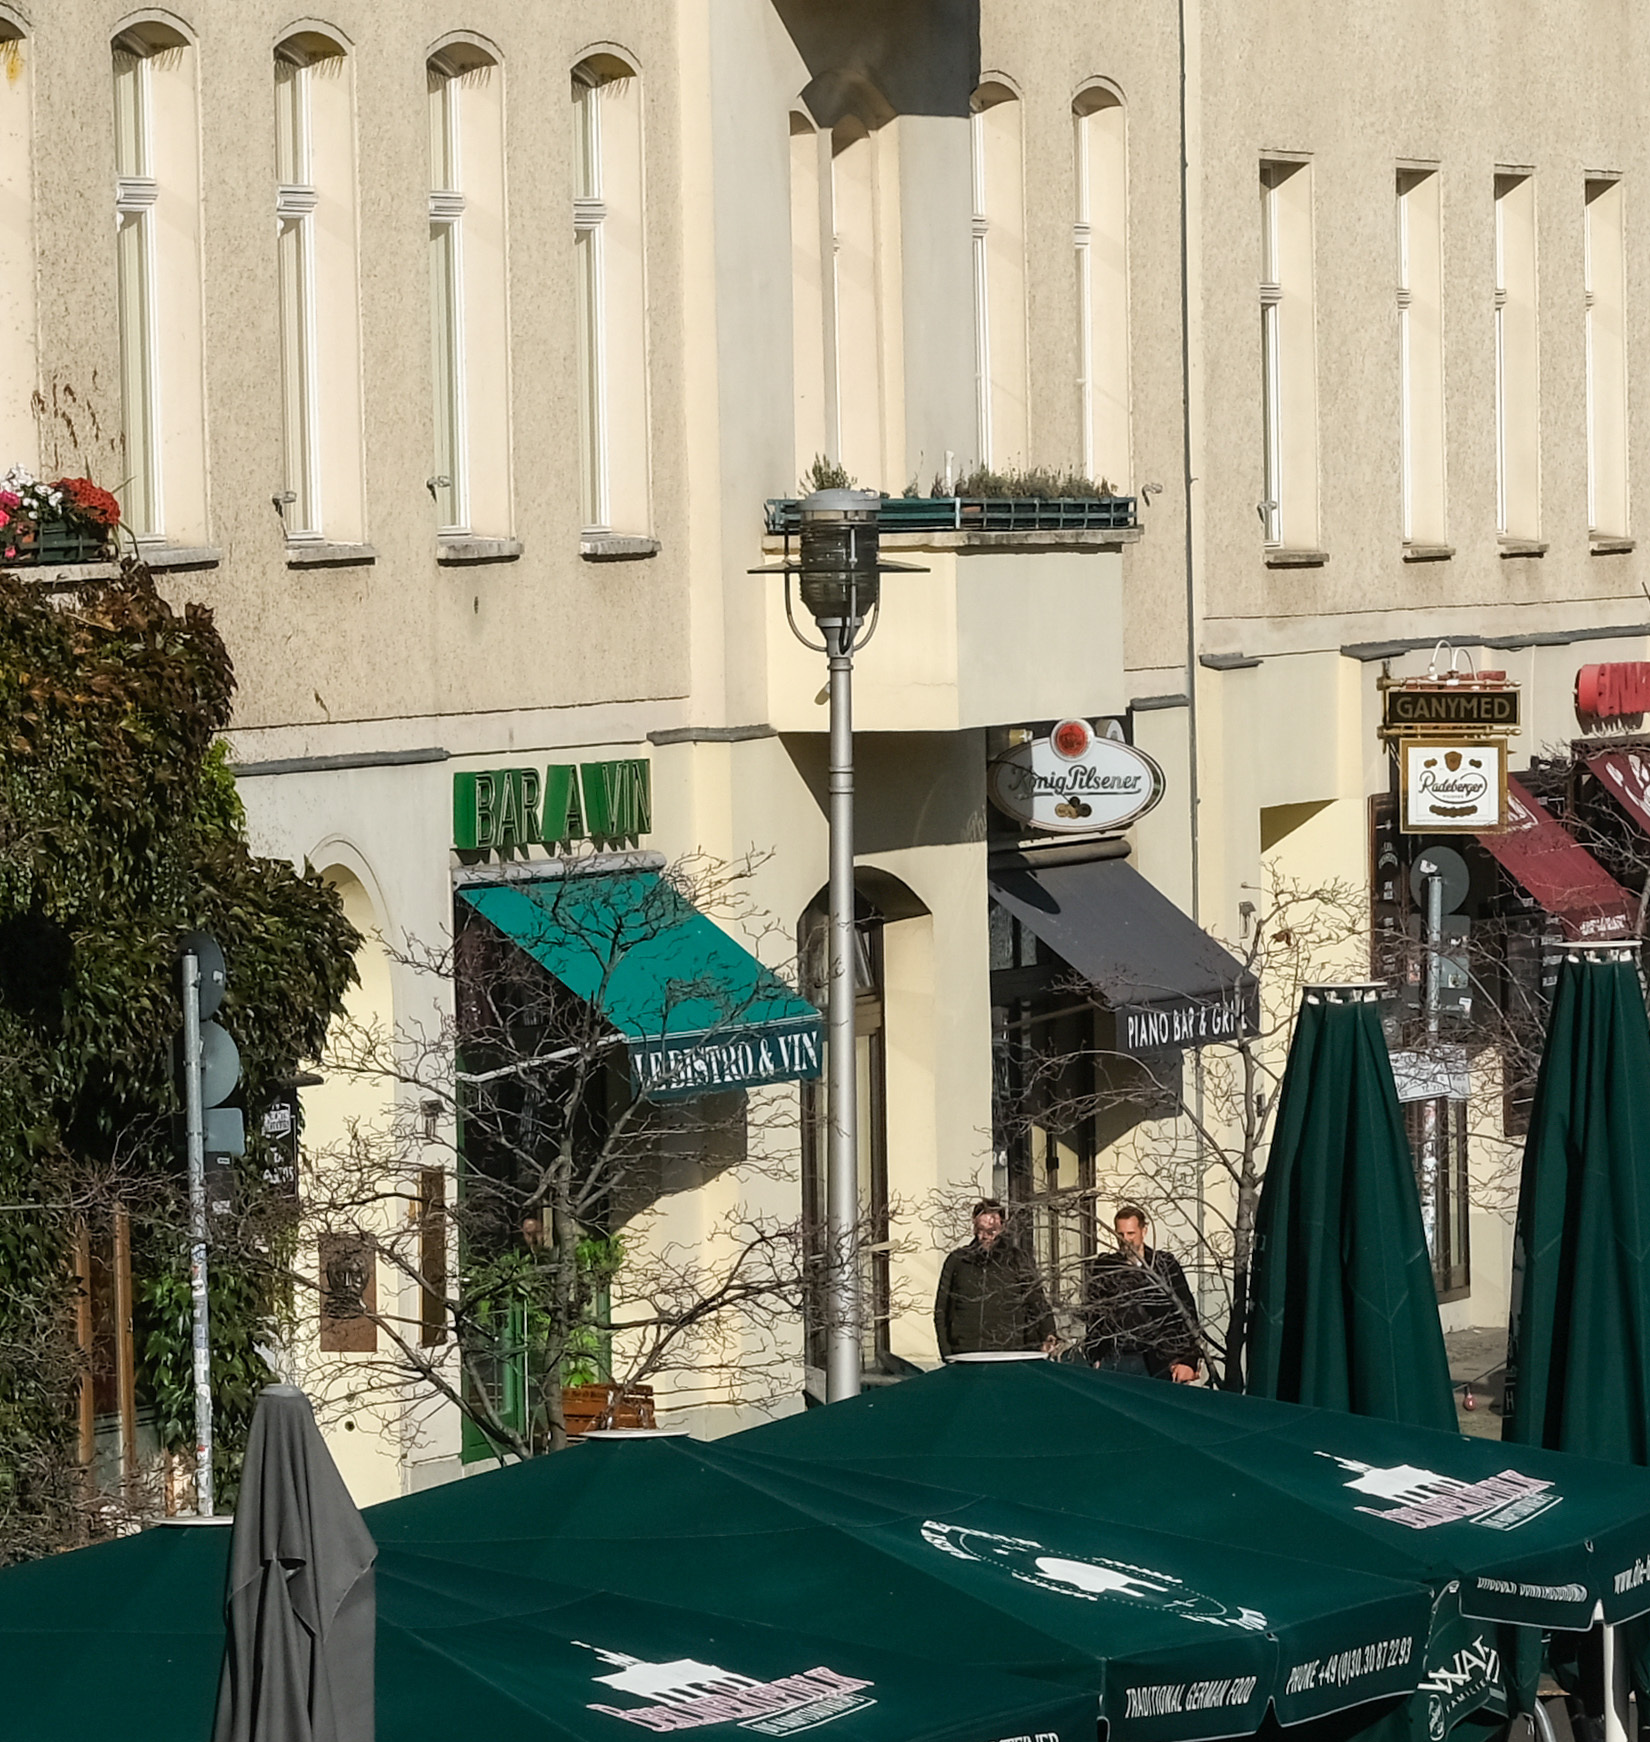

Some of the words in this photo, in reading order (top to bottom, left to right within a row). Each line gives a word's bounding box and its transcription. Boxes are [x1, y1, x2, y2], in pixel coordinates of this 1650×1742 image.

[1396, 696, 1511, 719] GANYMED
[1066, 764, 1143, 791] Pilsener
[472, 768, 544, 849] BAR
[597, 759, 651, 837] VIN
[1127, 1012, 1169, 1050] PIANO
[1173, 1006, 1195, 1042] BAR
[1212, 999, 1248, 1035] GRIL
[778, 1030, 819, 1074] VIN
[1124, 1683, 1186, 1718] TRADITIONAL
[1185, 1679, 1231, 1711] GERMAN
[1228, 1675, 1257, 1705] FOOD
[1285, 1659, 1320, 1695] PHONE
